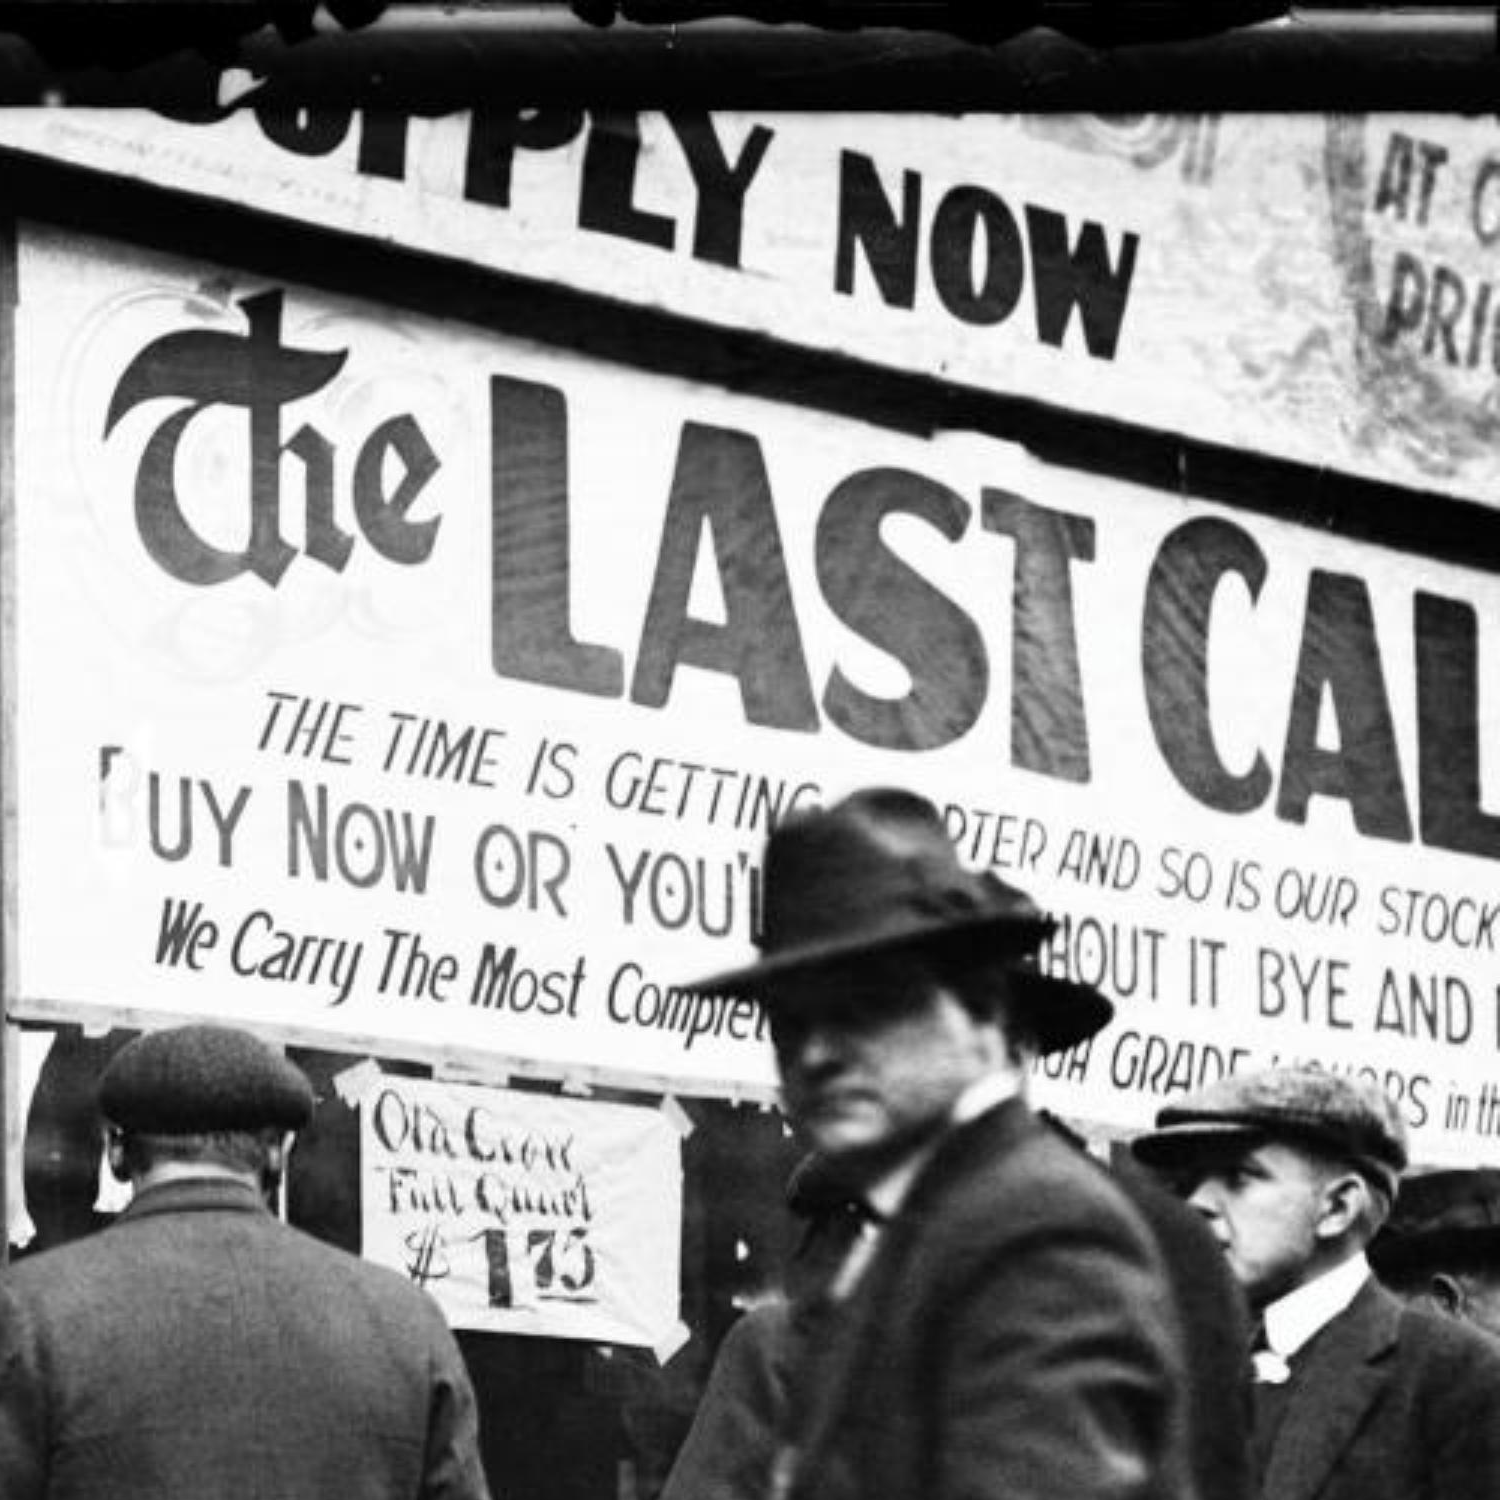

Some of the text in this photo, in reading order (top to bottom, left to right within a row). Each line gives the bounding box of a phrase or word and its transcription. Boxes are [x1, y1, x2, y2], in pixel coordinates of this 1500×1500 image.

[834, 147, 1140, 361] NOW
[1374, 131, 1448, 226] AT
[1378, 250, 1500, 376] PRI
[102, 287, 444, 588] The
[488, 374, 1096, 785] LAST
[100, 744, 253, 868] UY
[288, 779, 435, 895] NOW
[474, 824, 569, 919] OR
[1188, 933, 1227, 1010] IT
[1258, 947, 1353, 1030] BYE
[1374, 968, 1473, 1045] AND
[258, 691, 362, 765] THE
[383, 712, 505, 787] TIME
[526, 738, 577, 799] IS
[1058, 830, 1140, 890] AND
[1158, 845, 1213, 902] SO
[1225, 860, 1262, 912] IS
[1275, 869, 1357, 925] OUR
[1379, 887, 1500, 948] STOCK
[155, 897, 219, 971] We
[230, 910, 364, 1006] Carry
[377, 929, 459, 1002] The
[470, 942, 586, 1018] Most
[373, 1088, 457, 1160] Old
